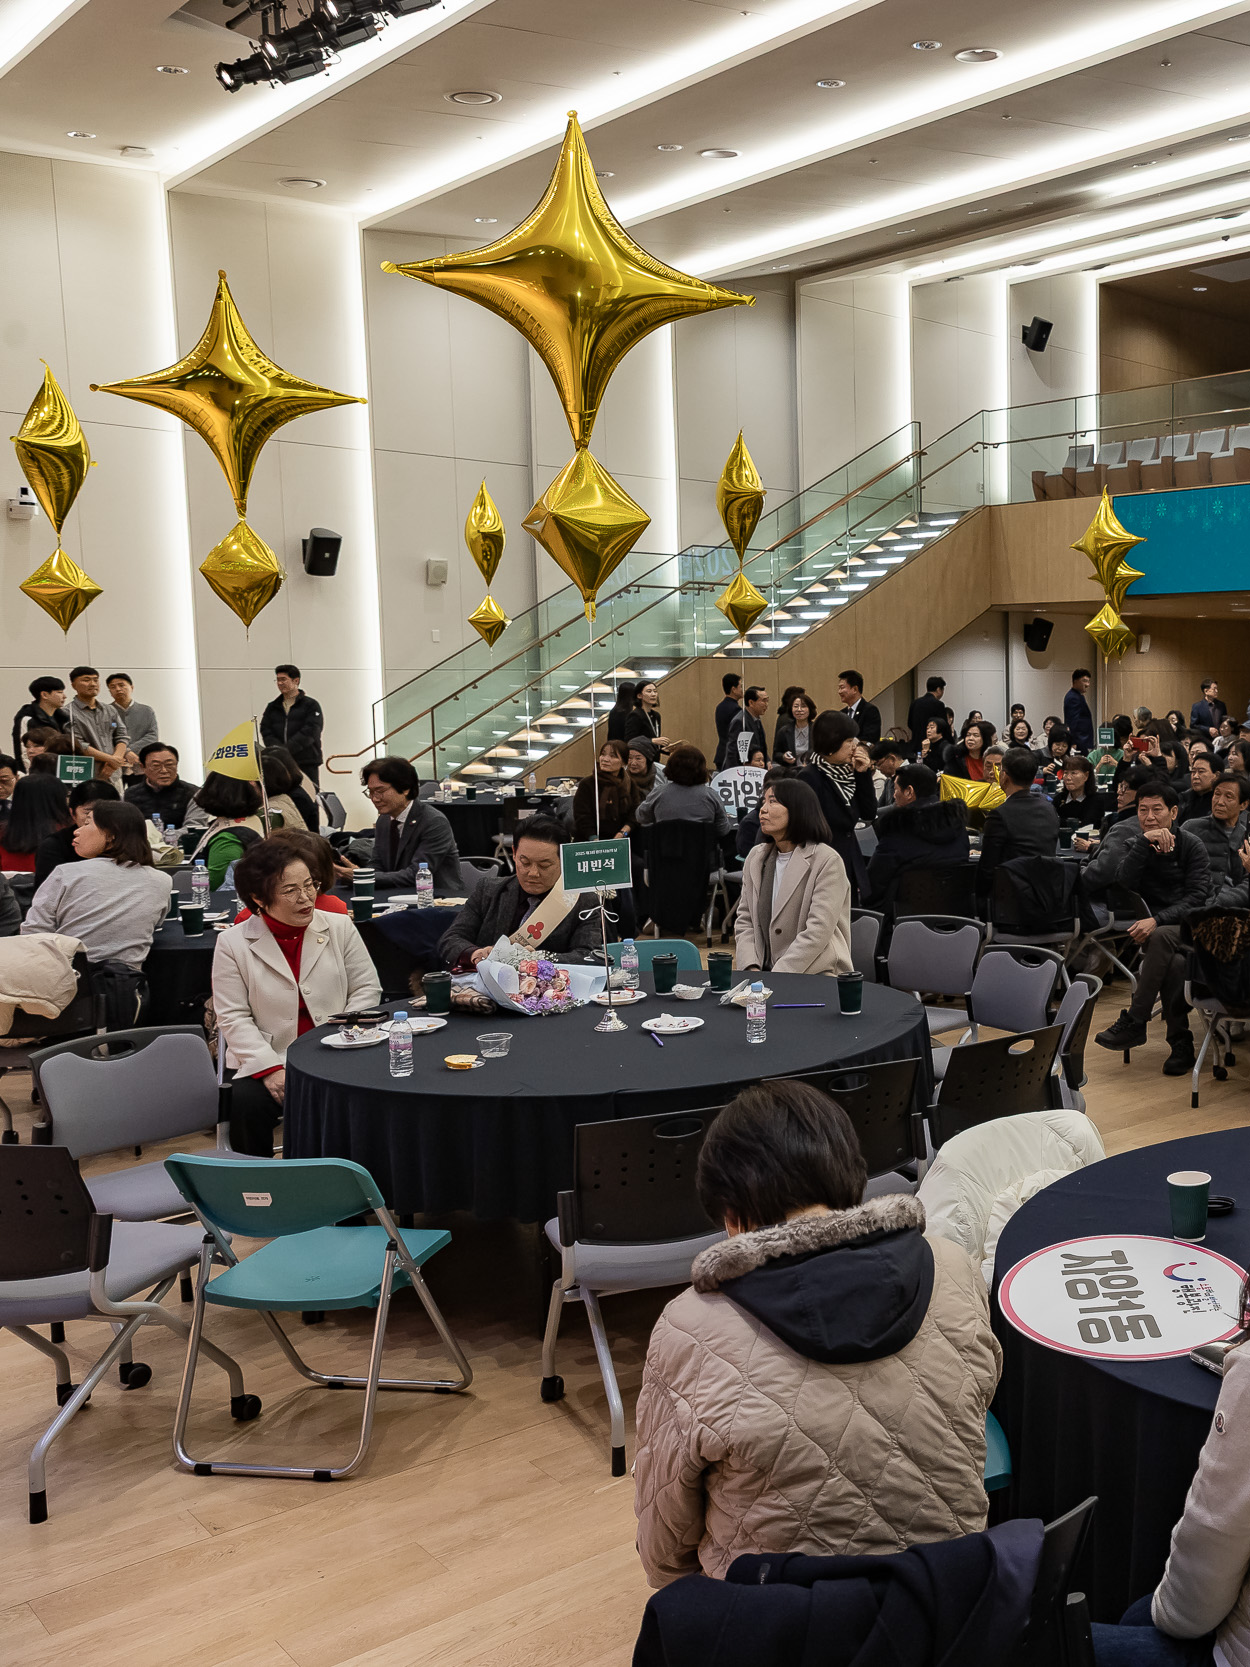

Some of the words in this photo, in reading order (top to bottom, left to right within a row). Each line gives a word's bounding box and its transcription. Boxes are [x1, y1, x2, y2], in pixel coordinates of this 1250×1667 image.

[214, 743, 249, 760] 화양동
[718, 780, 763, 808] 화양
[577, 857, 615, 873] 내빈석
[1060, 1249, 1163, 1344] 자양1동
